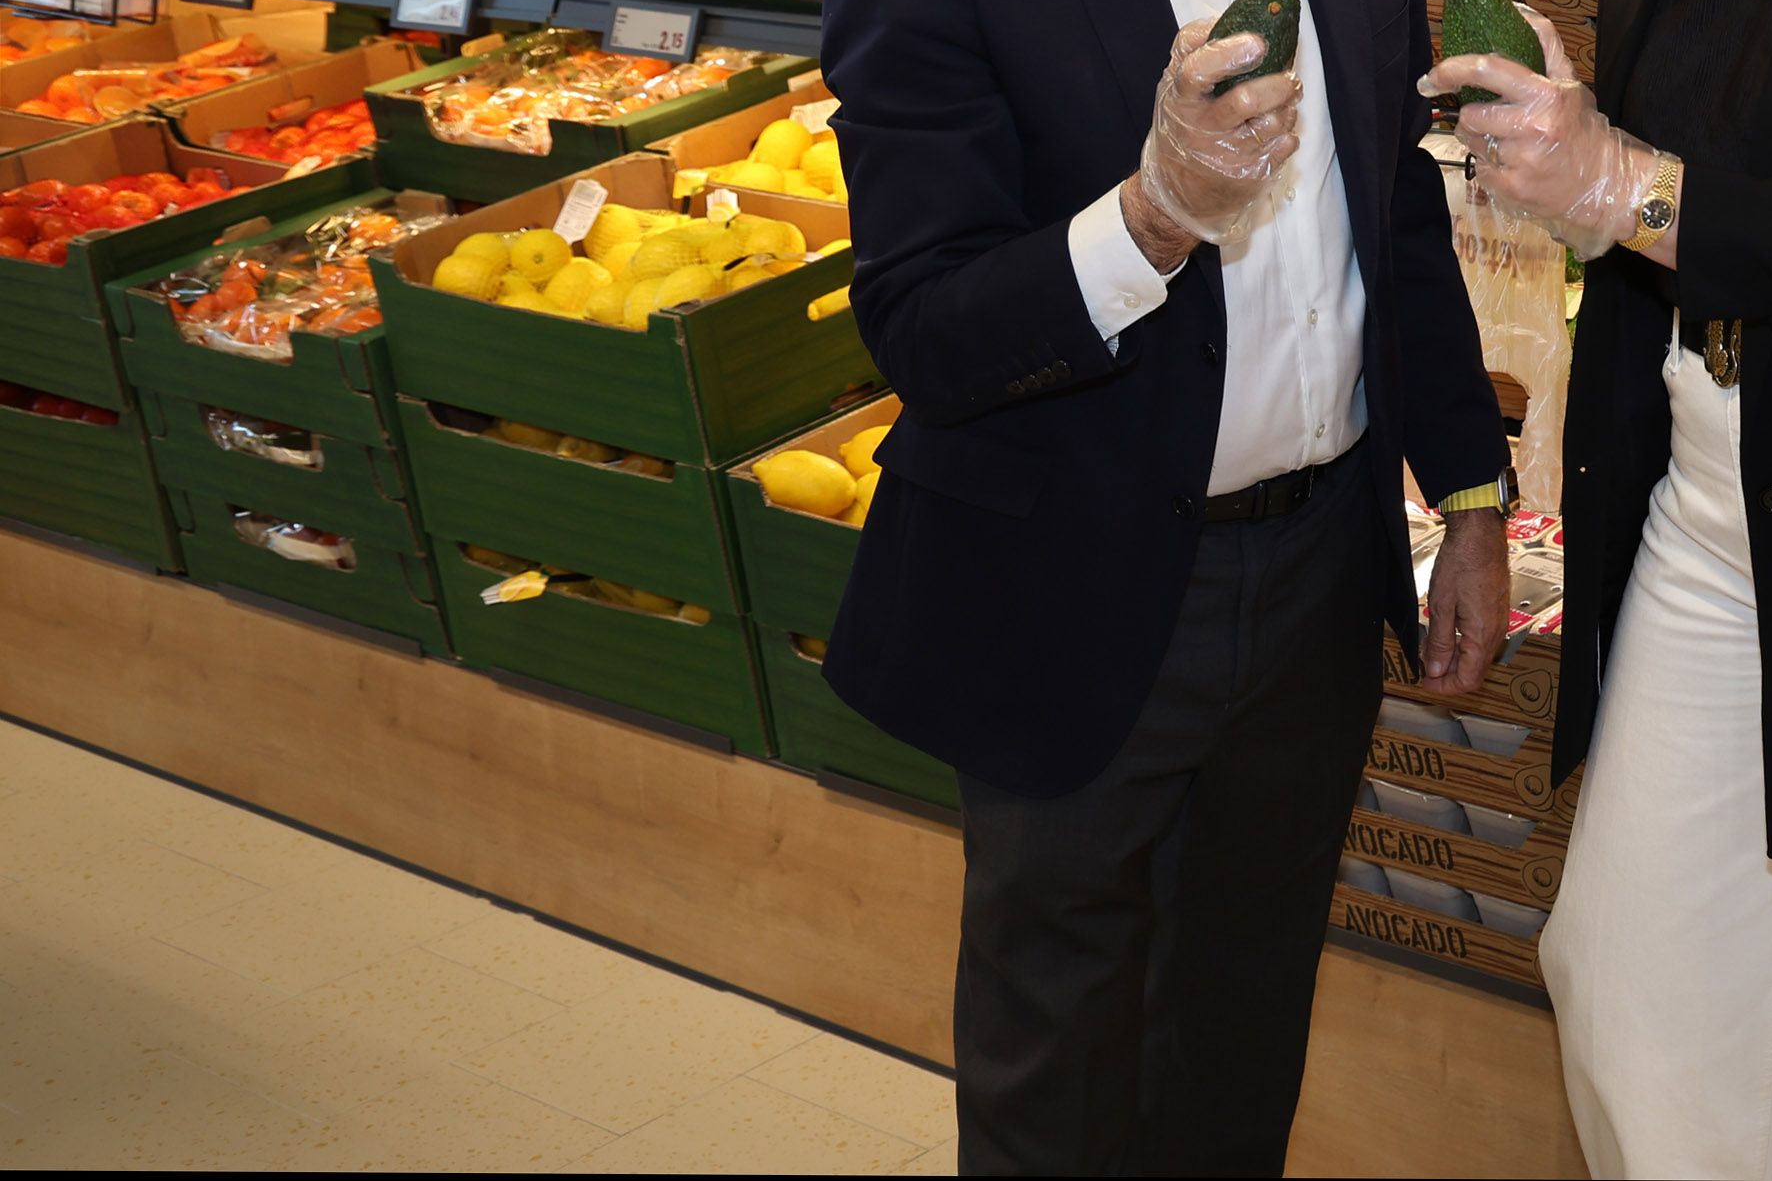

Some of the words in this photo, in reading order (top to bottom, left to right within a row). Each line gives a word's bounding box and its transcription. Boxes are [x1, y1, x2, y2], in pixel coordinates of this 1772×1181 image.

[1369, 739, 1447, 781] CADO
[1346, 825, 1456, 872] VOCADO
[1344, 903, 1468, 959] AVOCADO
